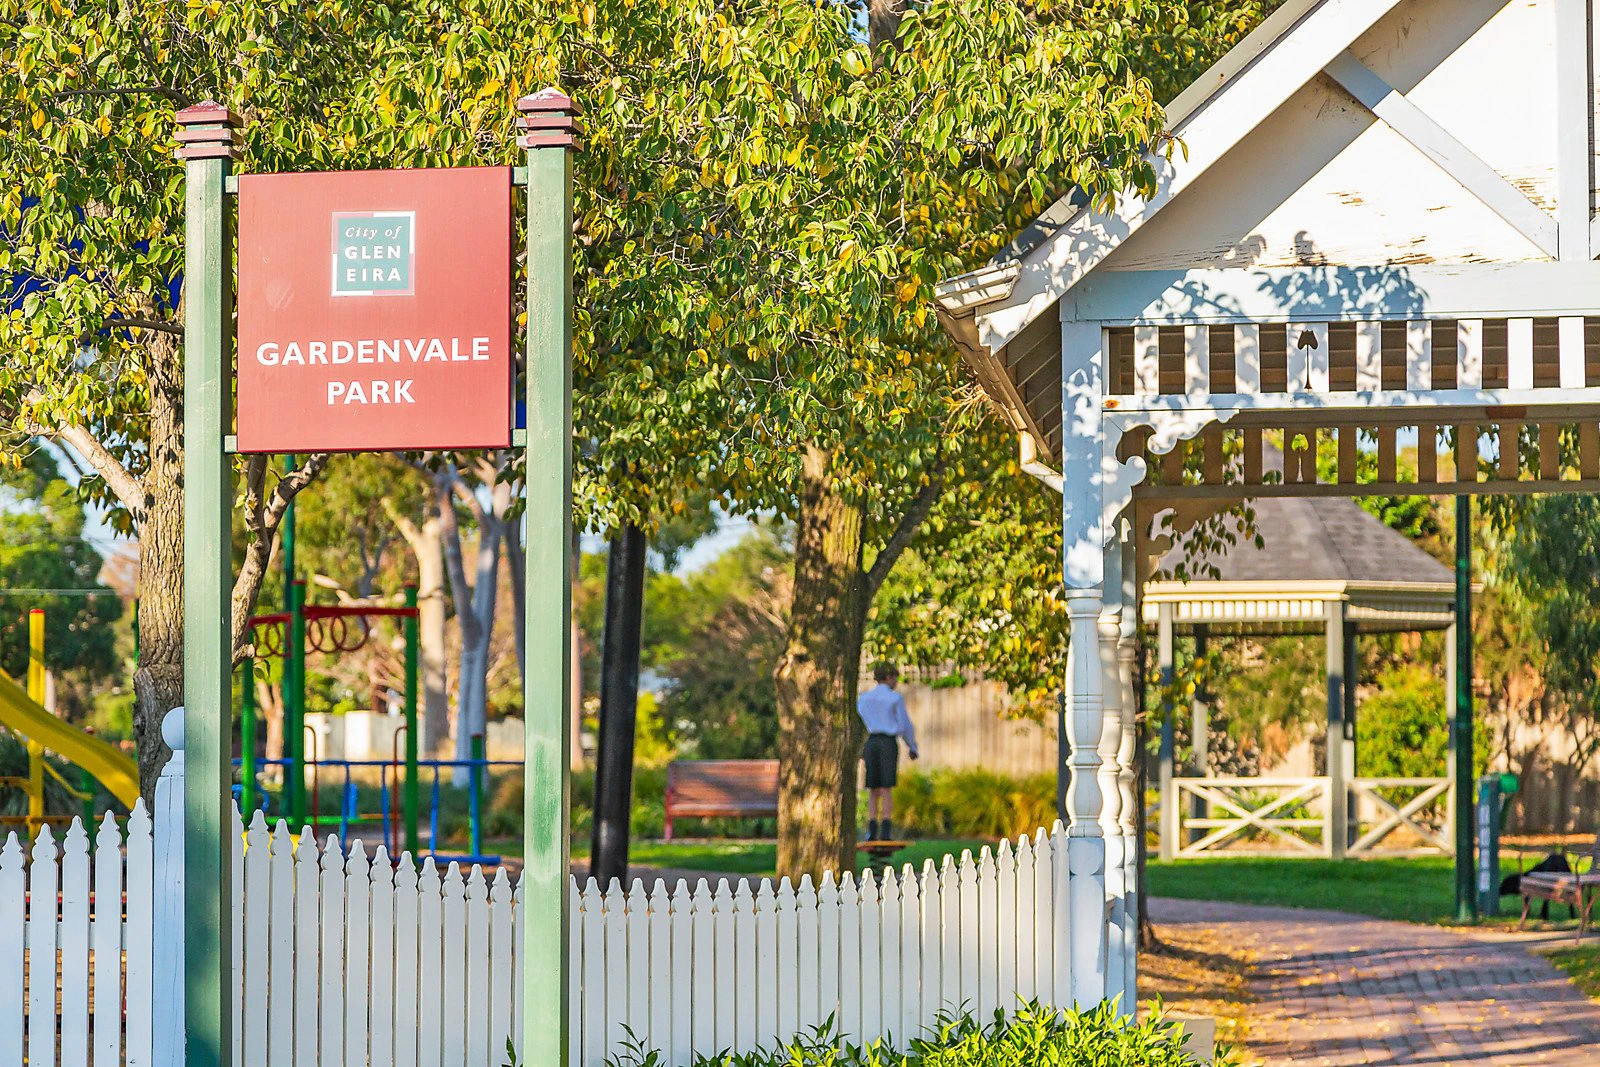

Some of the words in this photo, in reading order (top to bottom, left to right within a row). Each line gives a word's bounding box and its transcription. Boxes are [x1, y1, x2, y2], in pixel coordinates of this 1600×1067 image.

[345, 226, 378, 240] City
[384, 225, 402, 239] of
[344, 245, 401, 260] GLEN
[346, 267, 402, 282] EIRA
[256, 337, 490, 366] GARDENVALE
[327, 379, 416, 405] PARK
